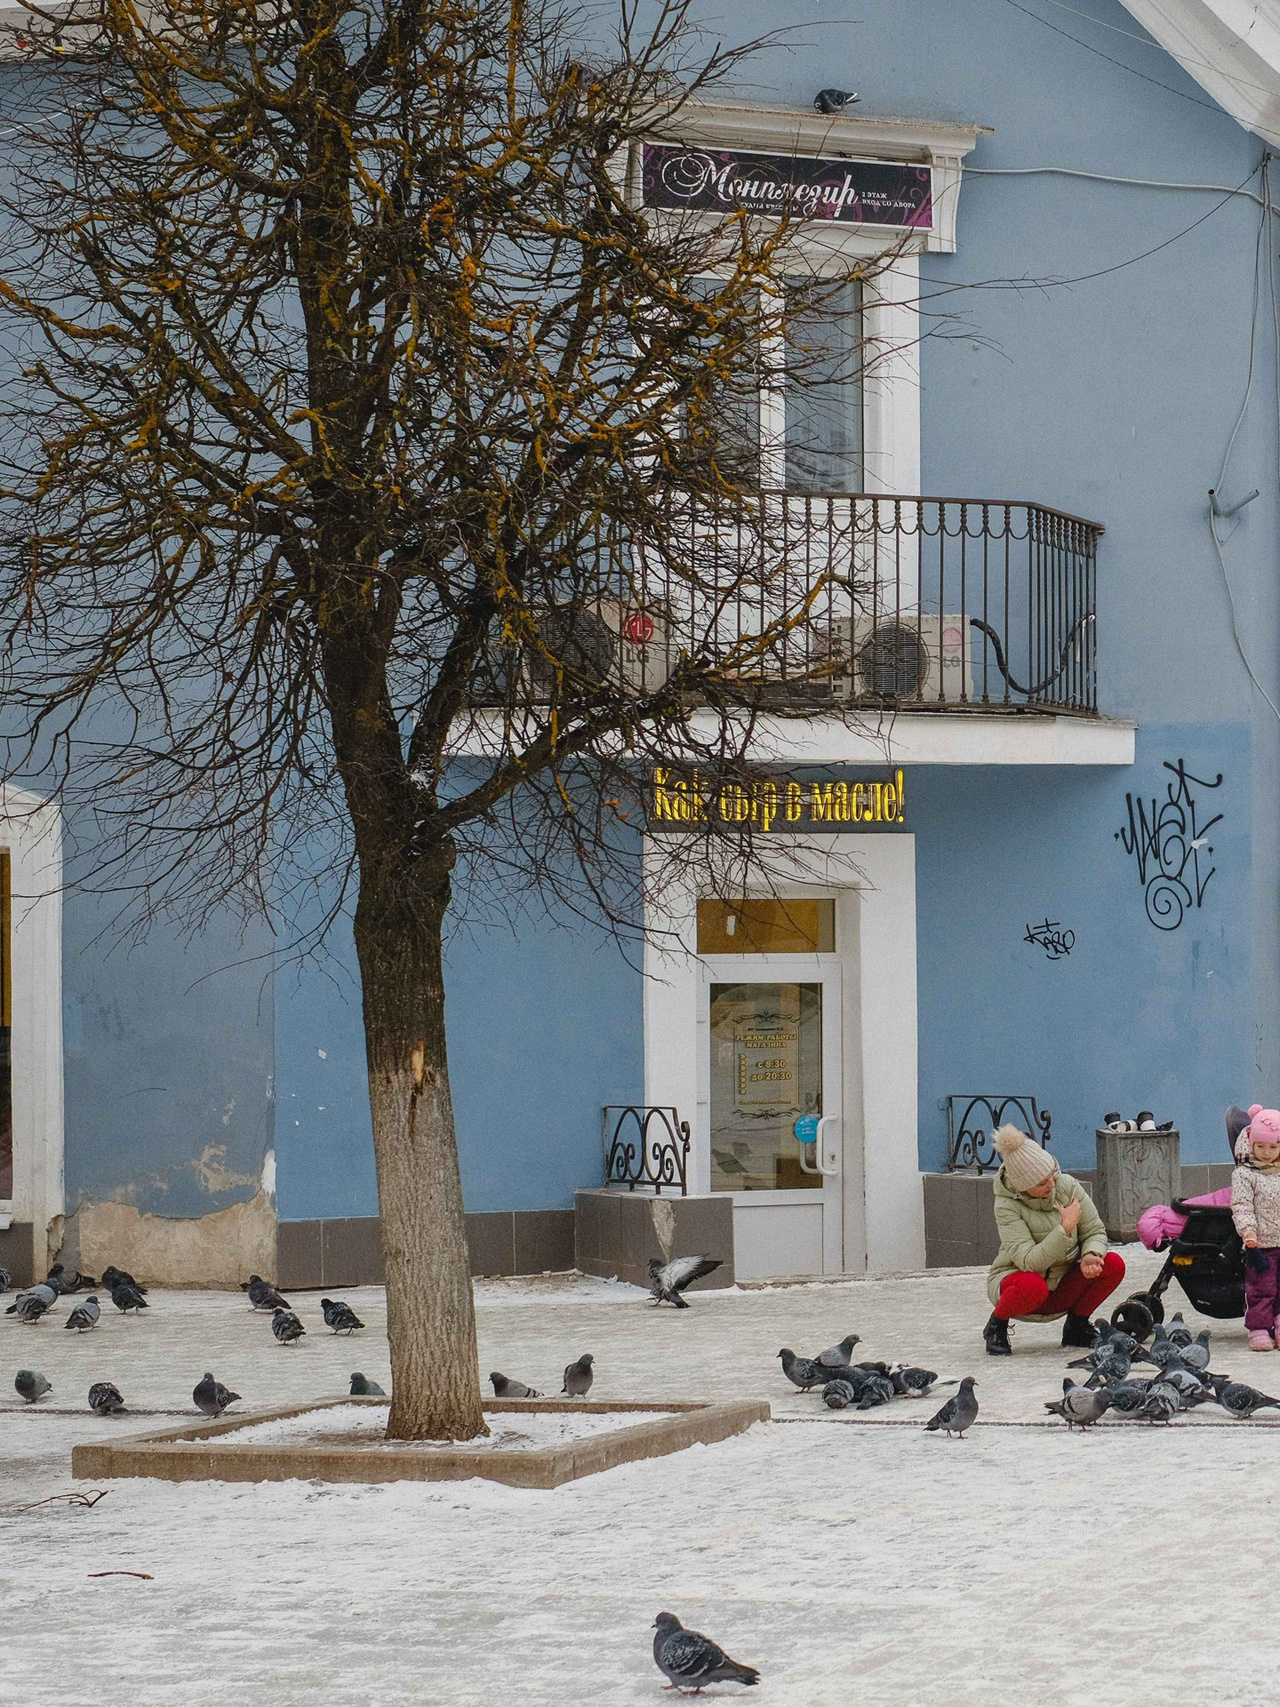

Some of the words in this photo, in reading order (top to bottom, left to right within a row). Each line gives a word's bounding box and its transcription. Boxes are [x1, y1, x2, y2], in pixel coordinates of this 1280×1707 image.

[867, 191, 888, 199] ЭТАЖ
[893, 201, 916, 209] ДВОРА
[626, 649, 649, 663] LG
[719, 781, 777, 832] сыр
[811, 769, 905, 823] масле!
[765, 1060, 786, 1068] 8:30
[751, 1074, 763, 1082] до
[765, 1072, 792, 1081] 20:30
